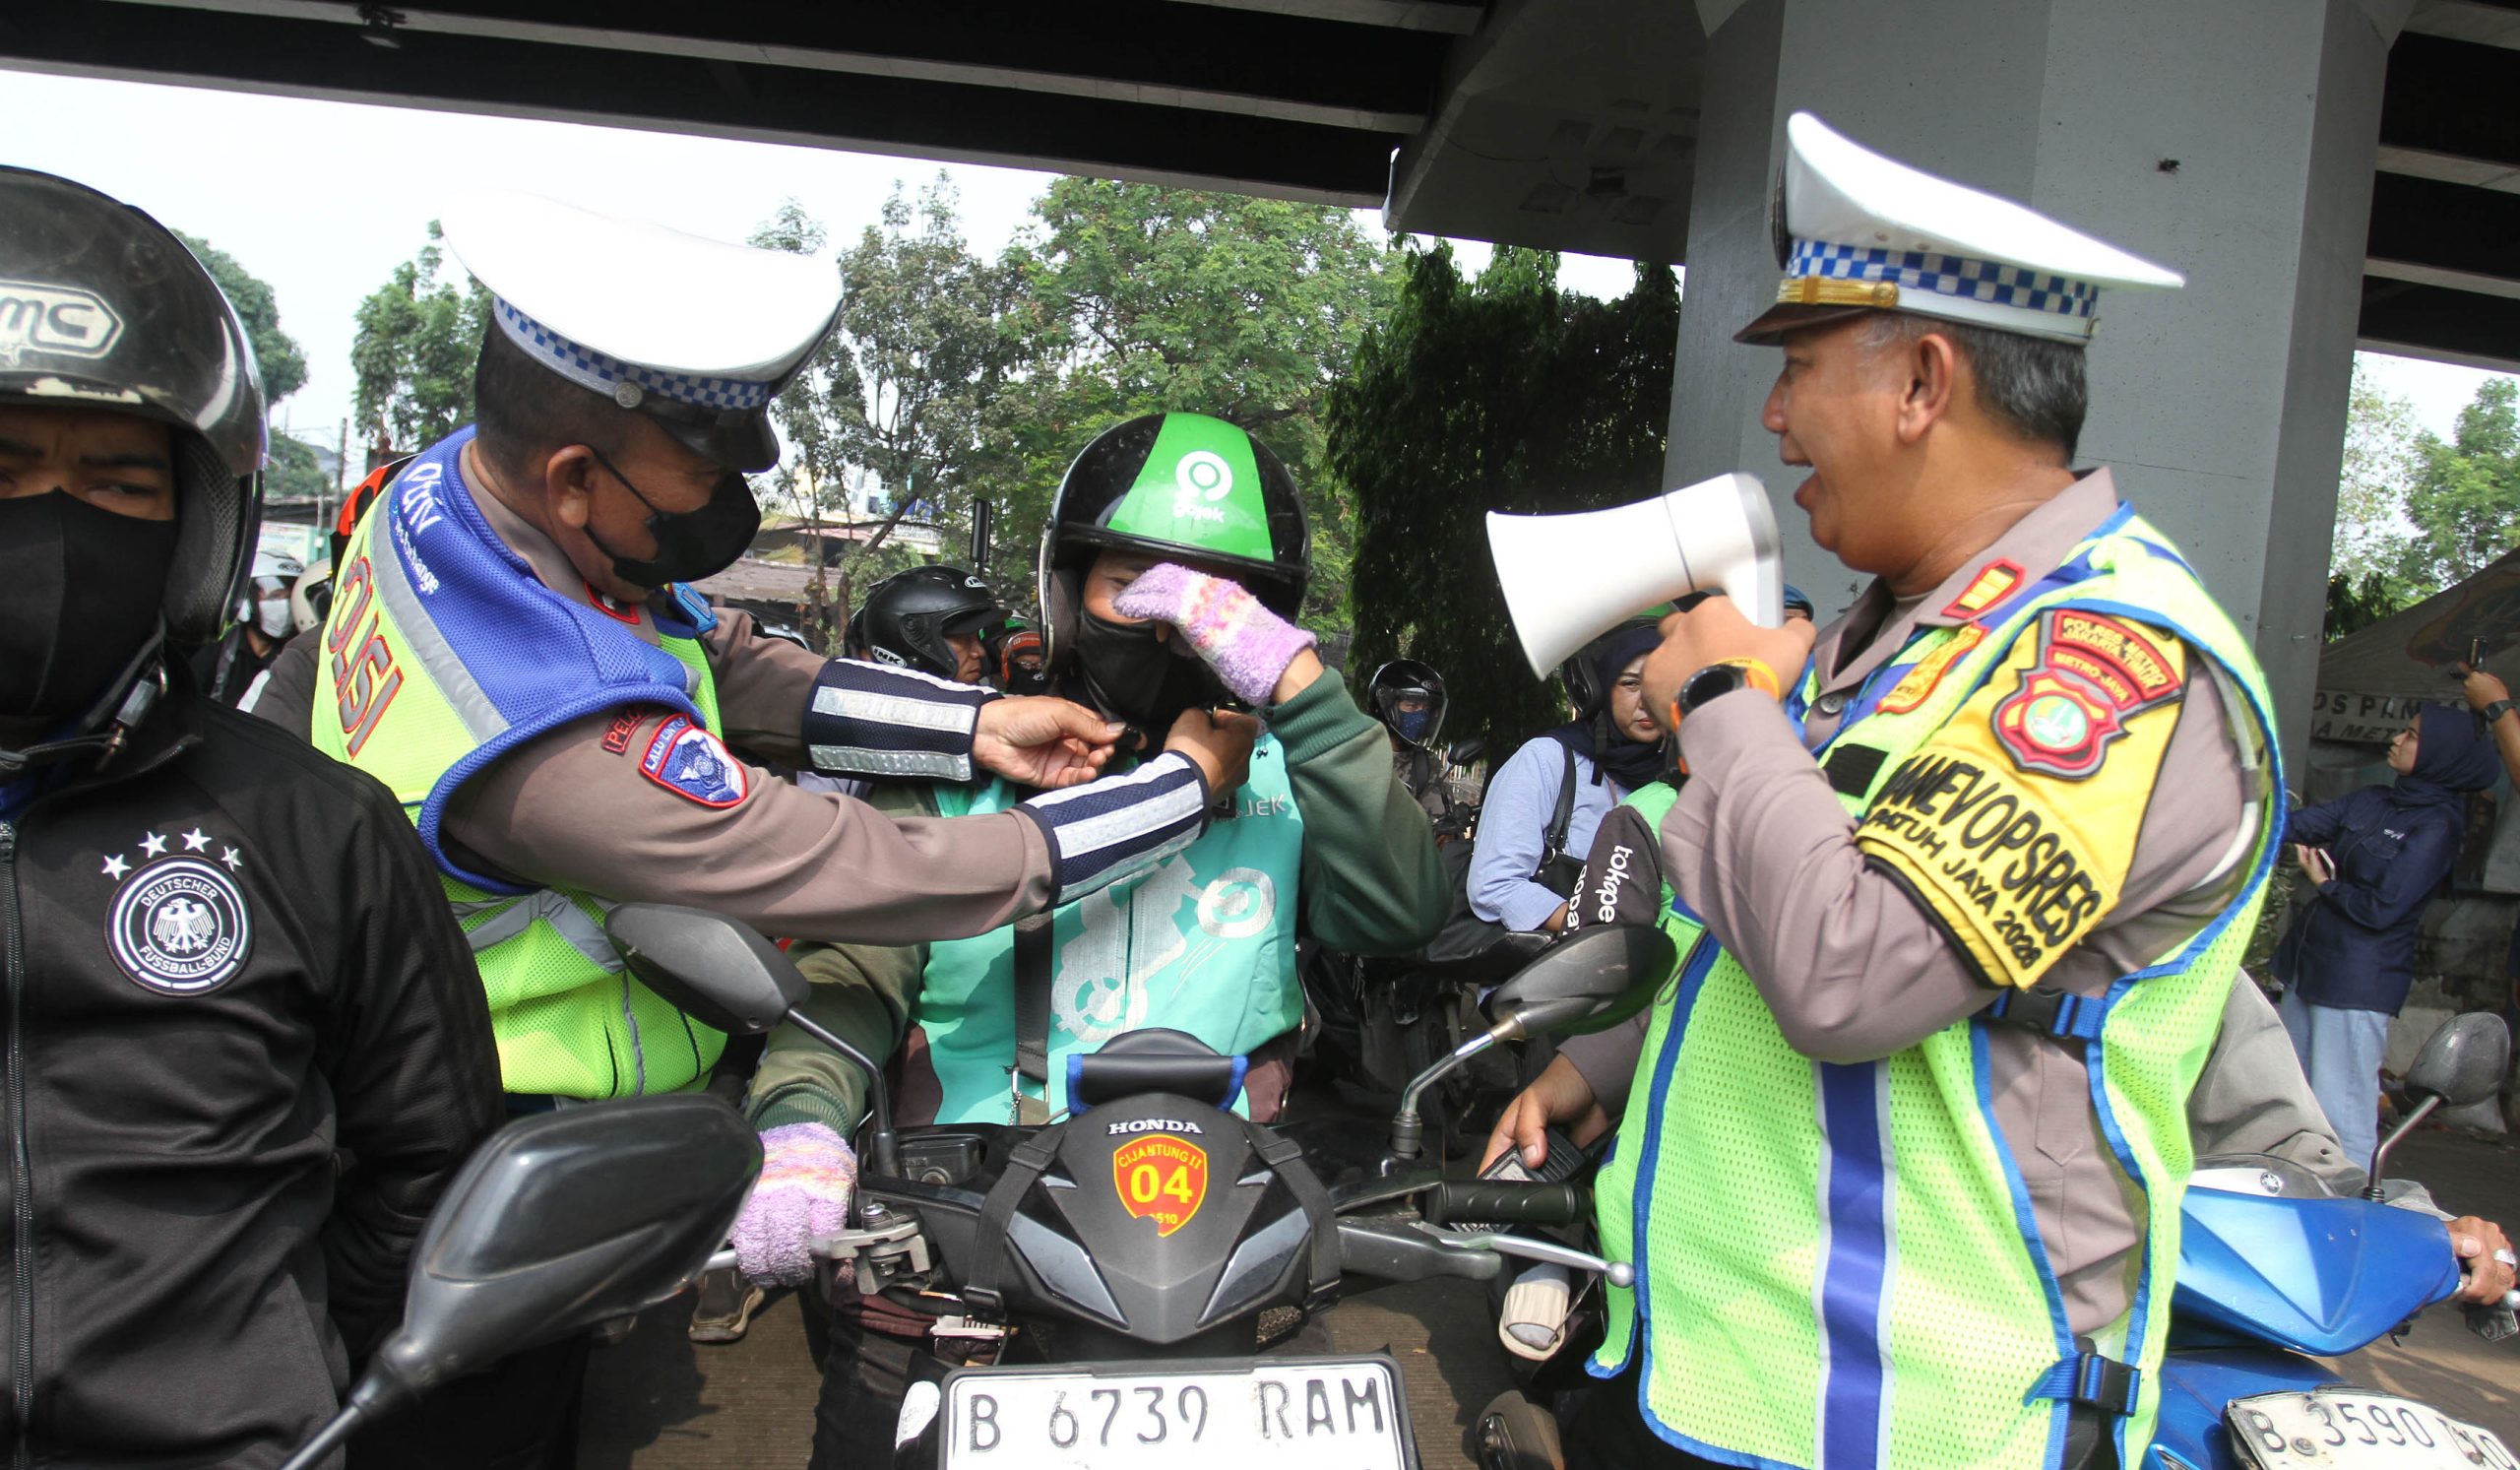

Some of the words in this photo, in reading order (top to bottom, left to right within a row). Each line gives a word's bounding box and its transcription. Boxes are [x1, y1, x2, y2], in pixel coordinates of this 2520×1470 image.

[321, 547, 405, 761] OLISI
[873, 648, 901, 665] INK
[1237, 795, 1287, 818] JEK
[141, 878, 218, 907] DEUTSCHER
[1942, 859, 1998, 916] JAYA
[140, 936, 230, 974] FUSSBALL-BUND
[1108, 1118, 1203, 1135] HONDA
[1118, 1143, 1189, 1168] CIJANTUNG
[1130, 1164, 1193, 1204] 04
[1150, 1213, 1178, 1225] 510
[970, 1394, 1000, 1452] B
[1048, 1385, 1208, 1448] 6739
[1257, 1377, 1385, 1440] RAM
[2245, 1408, 2287, 1453] B
[2305, 1401, 2435, 1447] 3590
